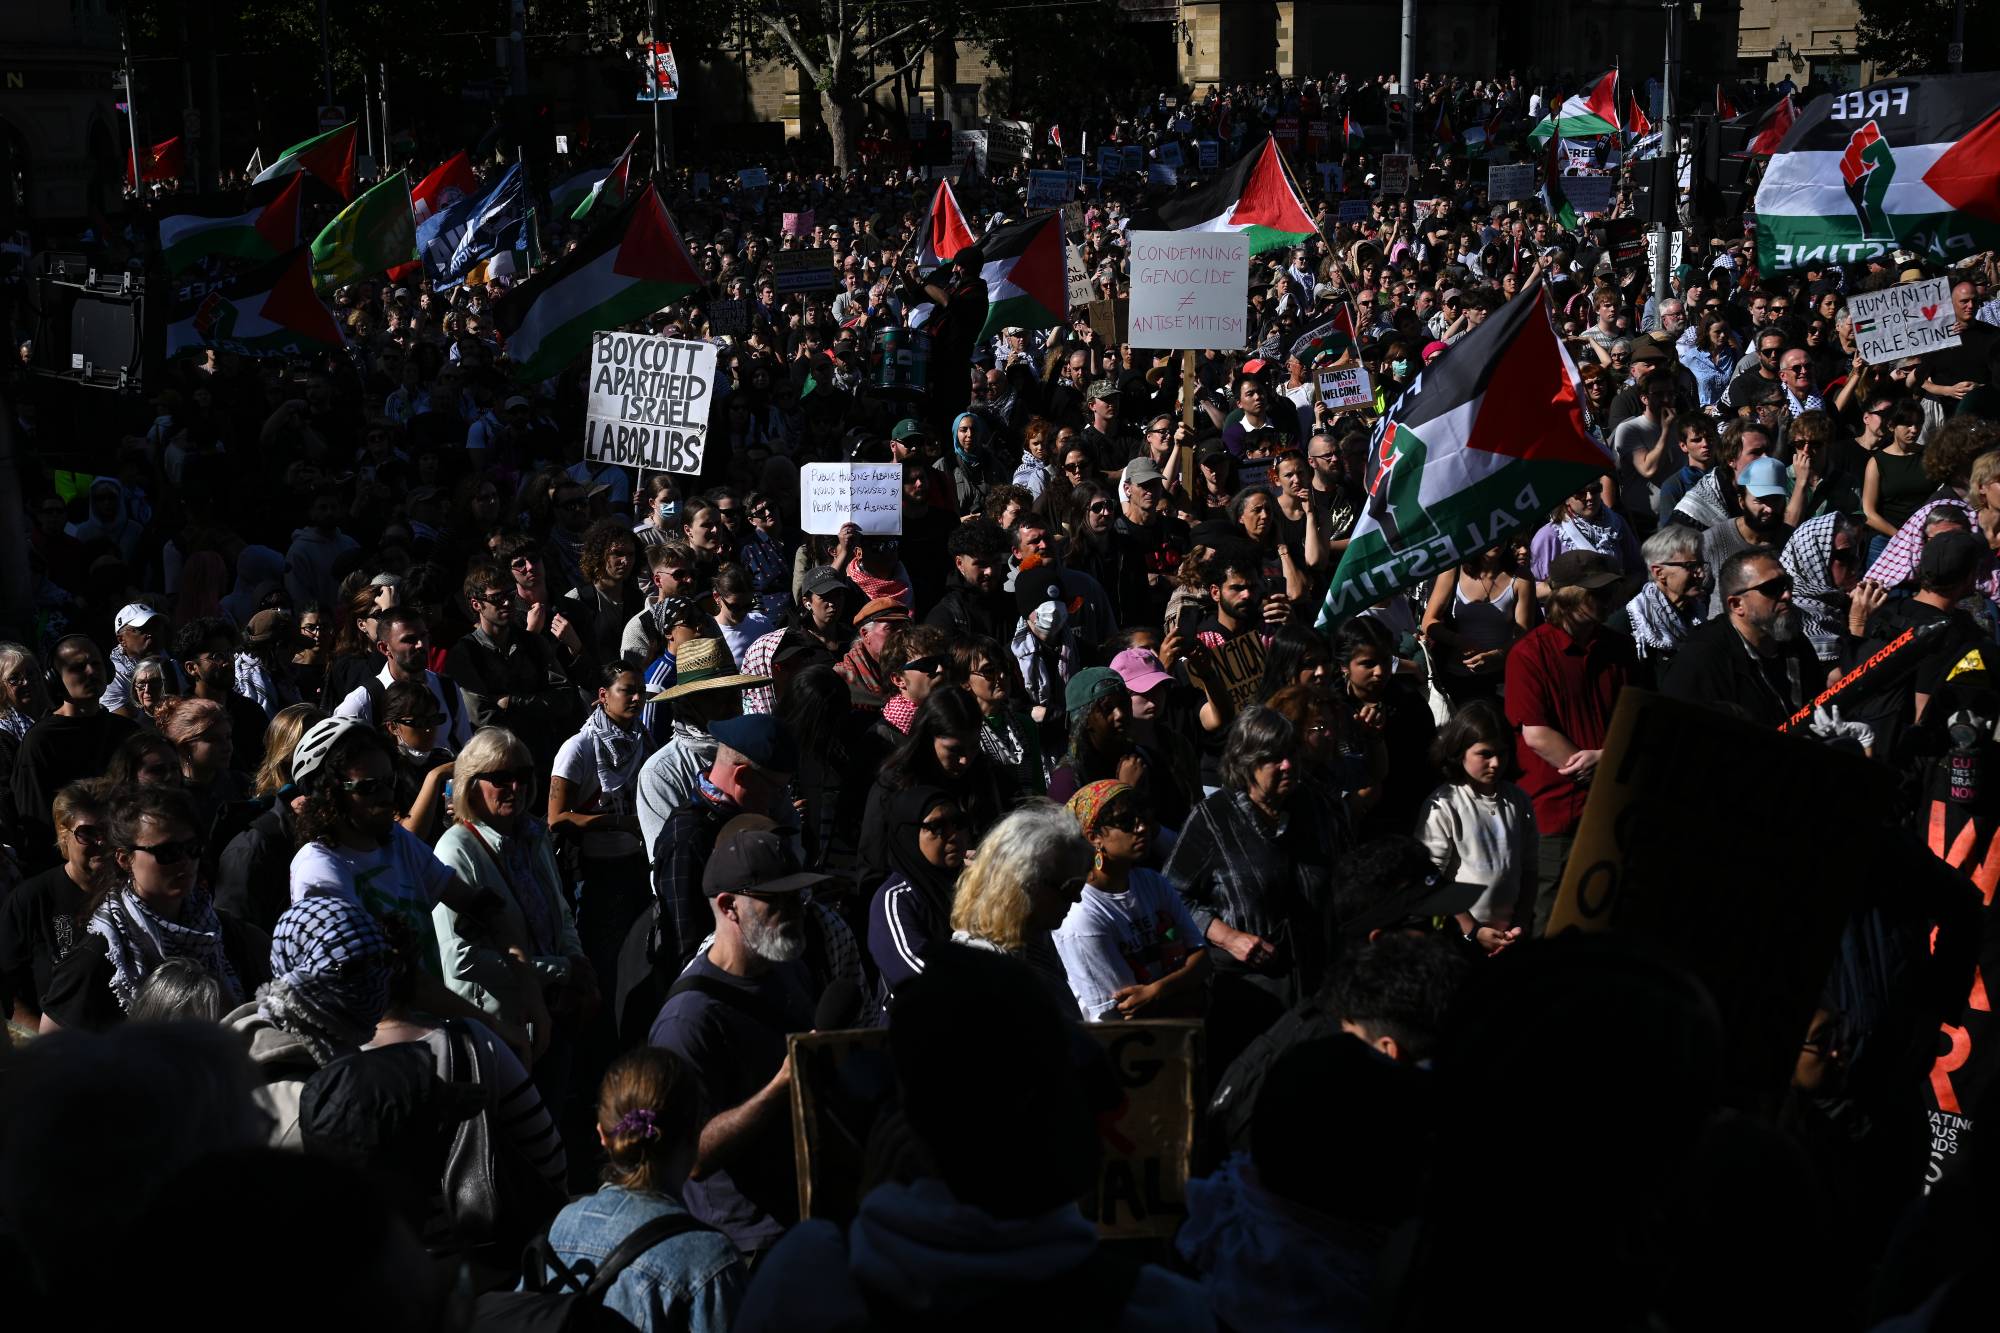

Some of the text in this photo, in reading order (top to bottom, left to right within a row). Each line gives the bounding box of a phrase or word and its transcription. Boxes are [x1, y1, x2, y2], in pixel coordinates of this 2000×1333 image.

[1568, 148, 1595, 158] FREE
[1137, 245, 1245, 261] CONDEMNING
[1140, 268, 1236, 285] GENOCIDE
[1856, 282, 1942, 316] HUMANITY
[1133, 315, 1242, 333] ANTISEMITISM
[1883, 308, 1920, 329] FOR
[1863, 323, 1956, 359] PALESTINE
[597, 334, 704, 375] BOYCOTT
[594, 365, 707, 401] APARTHEID
[1320, 369, 1357, 384] ZIONISTS
[1322, 384, 1362, 401] WELCOME
[1790, 703, 1811, 726] THE
